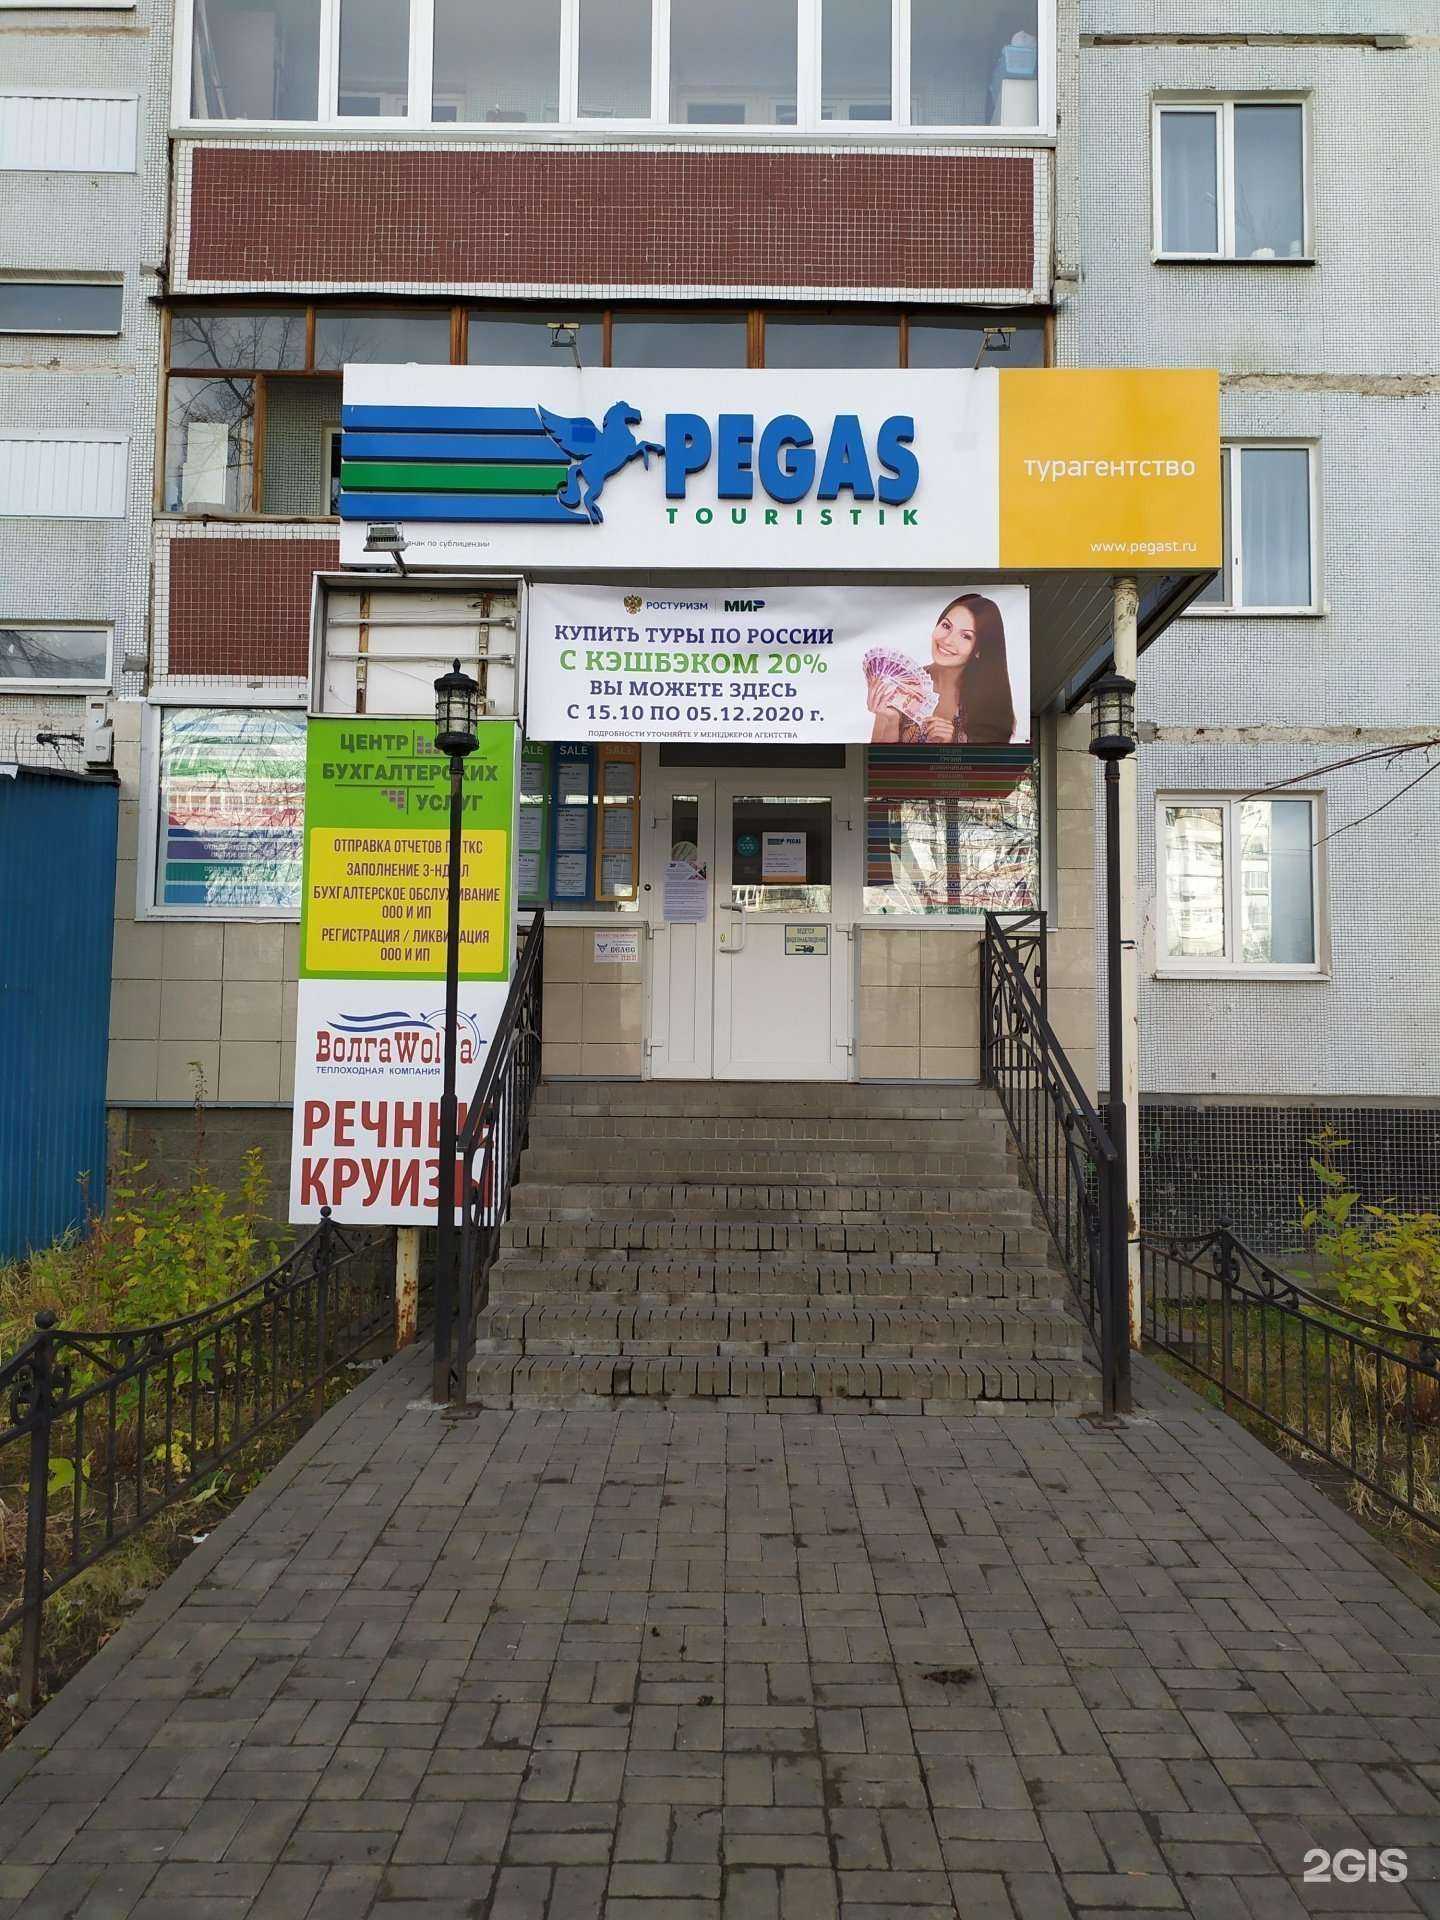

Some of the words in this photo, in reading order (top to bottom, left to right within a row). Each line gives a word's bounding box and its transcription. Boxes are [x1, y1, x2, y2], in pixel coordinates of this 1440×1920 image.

[665, 413, 920, 506] PEGAS
[1024, 459, 1196, 482] турагентство
[666, 508, 919, 525] TOURISTIK
[439, 537, 491, 549] сублицензии
[1090, 541, 1197, 555] www.pegast.ru
[646, 601, 708, 610] РОСТУРИЗМ
[724, 600, 766, 612] МИР
[555, 625, 639, 642] КУПИТЬ
[645, 627, 705, 644] ТУРЫ
[711, 628, 741, 644] ПО
[747, 629, 834, 645] РОССИИ
[559, 649, 577, 671] С
[585, 650, 759, 674] КЭШБЭКОМ
[767, 654, 828, 673] 20%
[590, 680, 623, 696] ВЫ
[629, 681, 723, 698] МОЖЕТЕ
[729, 683, 798, 700] ЗДЕСЬ
[567, 704, 580, 719] С
[587, 705, 644, 721] 15.10
[650, 706, 680, 721] ПО
[686, 706, 804, 722] 05.12.2020
[810, 709, 824, 722] г.
[588, 730, 645, 738] ПОДРОБНОСТИ
[647, 730, 692, 739] УТОЧНЯЙТЕ
[693, 731, 699, 739] У
[700, 731, 753, 739] МЕНЕДЖЕРОВ
[754, 731, 798, 739] АГЕНТСТВА
[340, 734, 409, 753] ЦЕНТР
[521, 745, 544, 755] ALE
[559, 745, 588, 756] SALE
[334, 839, 391, 853] ОТПРАВКА
[394, 840, 442, 854] ОТЧЕТОВ
[463, 840, 483, 854] ТКС
[347, 863, 420, 877] ЗАПОЛНЕНИЕ
[423, 863, 469, 878] 3-НДЛ
[313, 886, 406, 901] БУХГАЛТЕРСКОЕ
[409, 887, 500, 902] ОБСЛУИВАНИЕ
[382, 905, 403, 919] ООО
[406, 906, 414, 919] И
[417, 906, 432, 919] ИП
[322, 928, 400, 943] РЕГИСТРАЦИЯ
[404, 929, 410, 942] /
[413, 929, 490, 944] ЛИКВИАЦИЯ
[380, 947, 402, 961] ООО
[405, 948, 412, 961] И
[415, 948, 430, 961] ИП
[316, 1031, 473, 1064] ВолгаWola
[316, 1067, 385, 1075] ТЕПЛОХОДНАЯ
